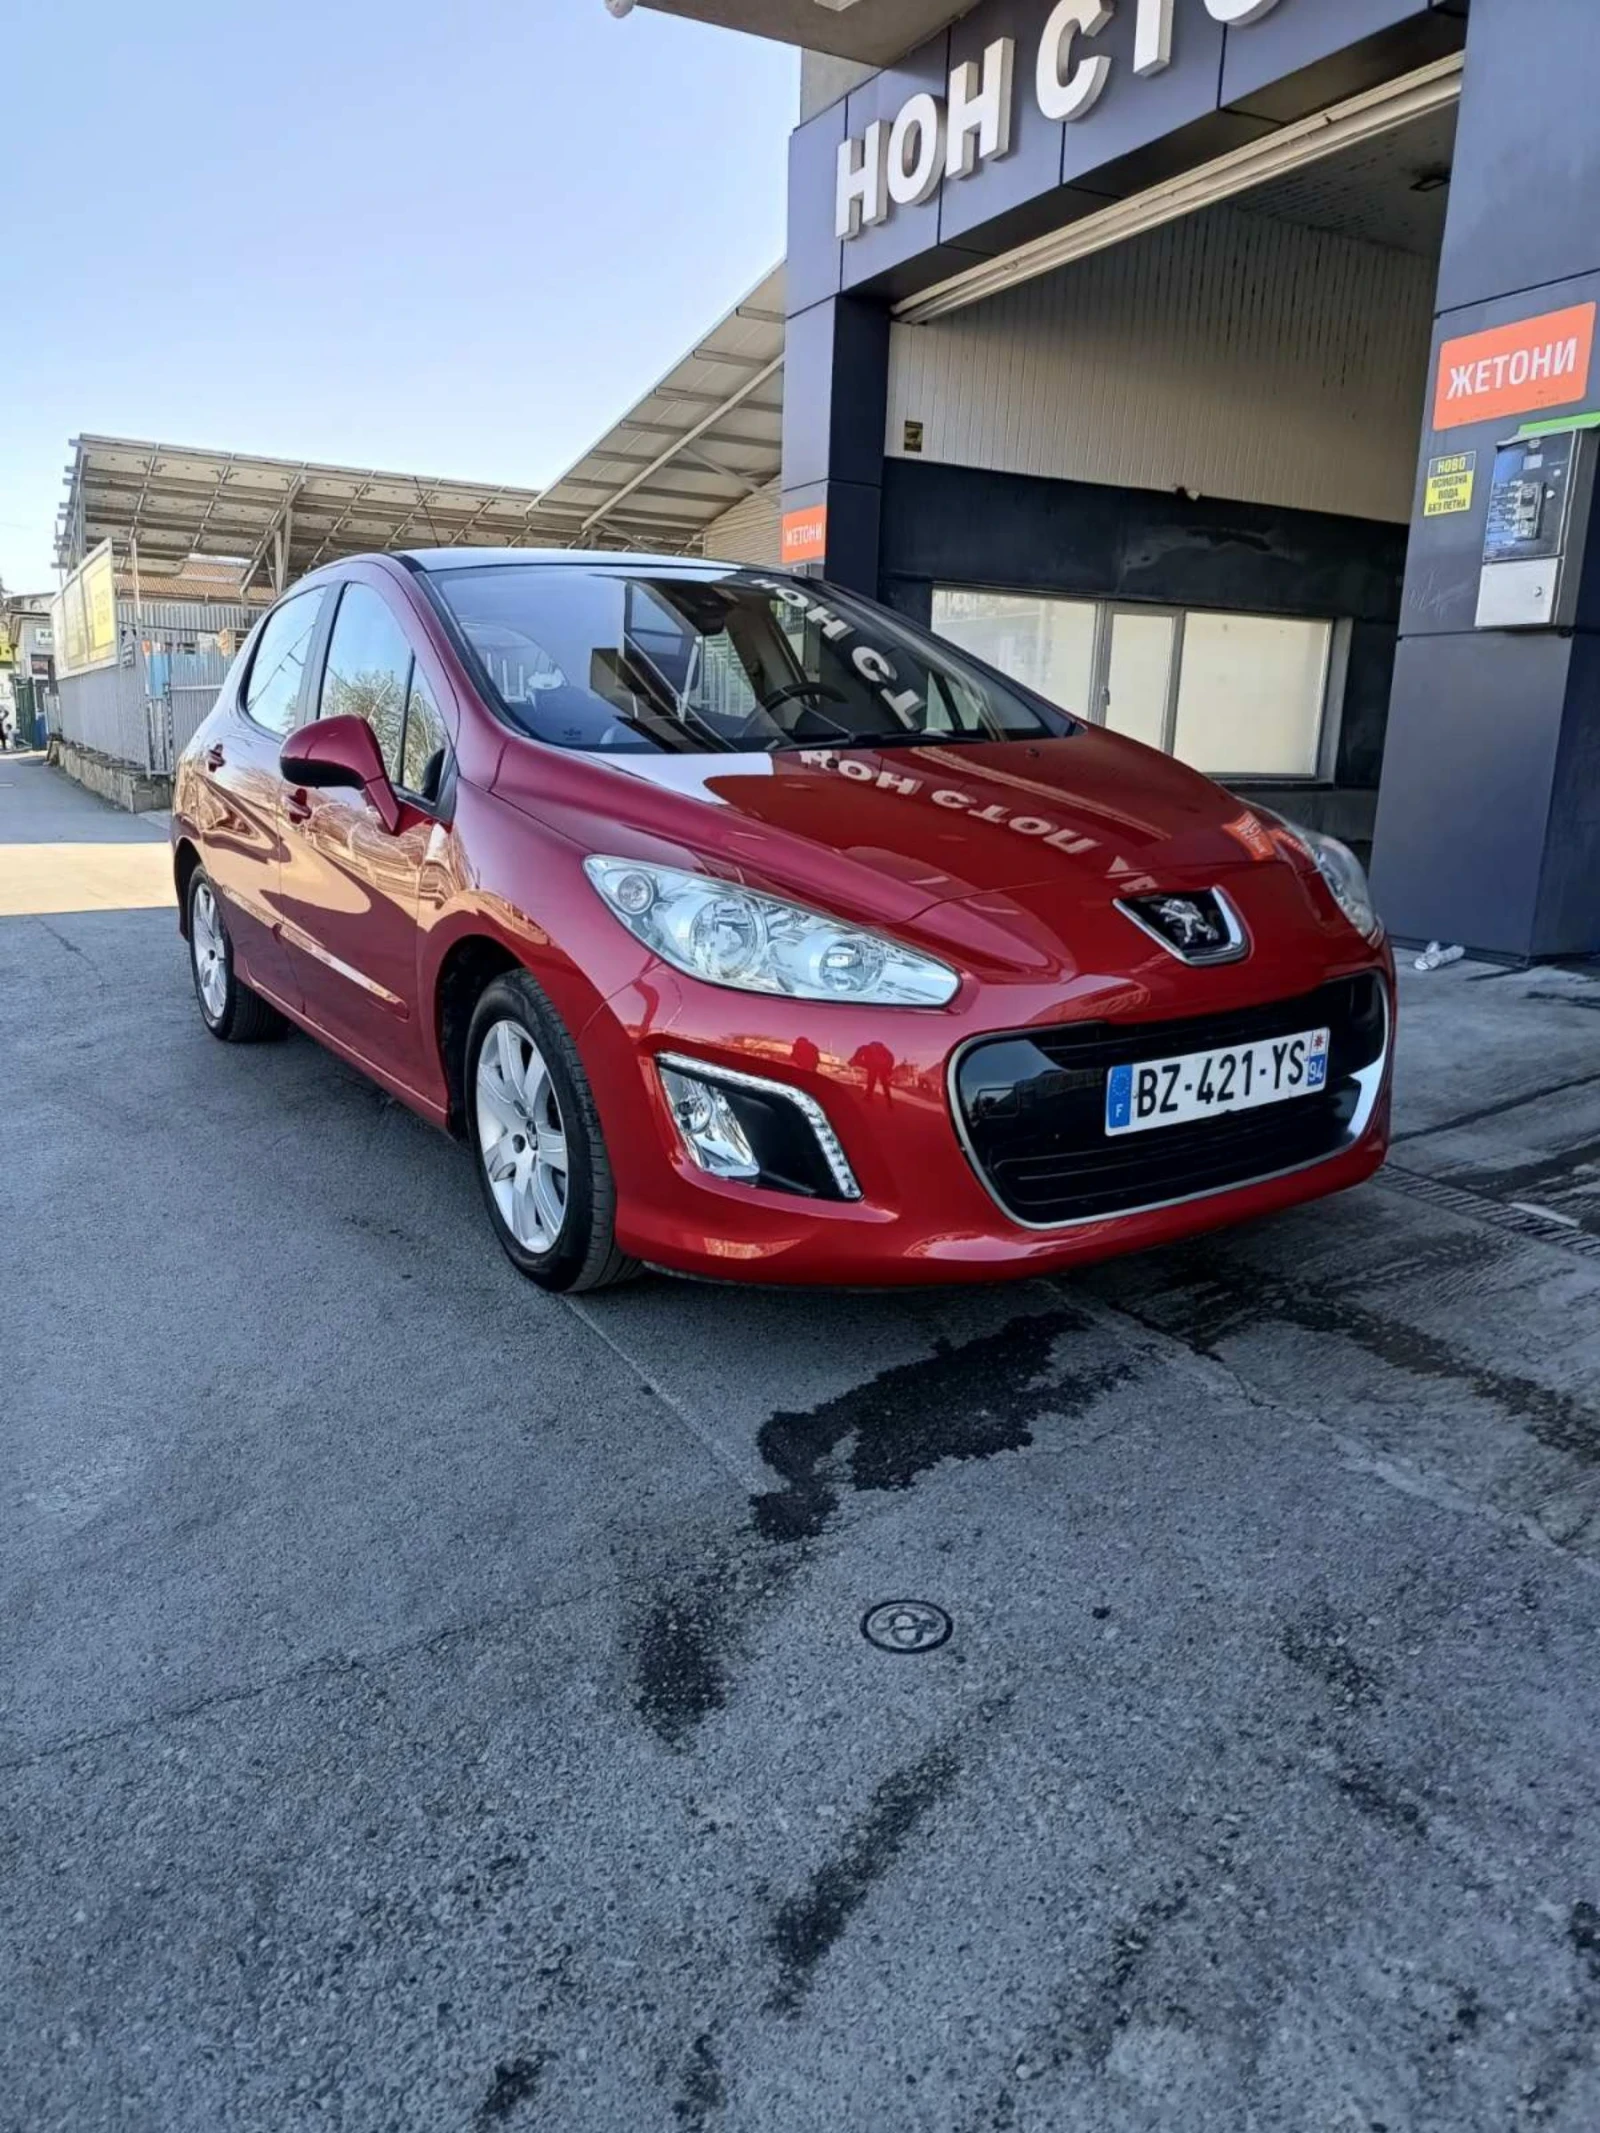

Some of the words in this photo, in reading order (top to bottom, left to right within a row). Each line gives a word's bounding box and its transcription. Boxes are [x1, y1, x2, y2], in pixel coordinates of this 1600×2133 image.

[835, 36, 1015, 240] НОН
[1447, 338, 1577, 399] ЖЕТОНИ
[1437, 456, 1466, 474] НОВО
[786, 522, 823, 547] ЖЕТОНИ
[1114, 1103, 1124, 1119] F
[1136, 1040, 1305, 1118] BZ-421-YS
[1308, 1059, 1324, 1082] 94
